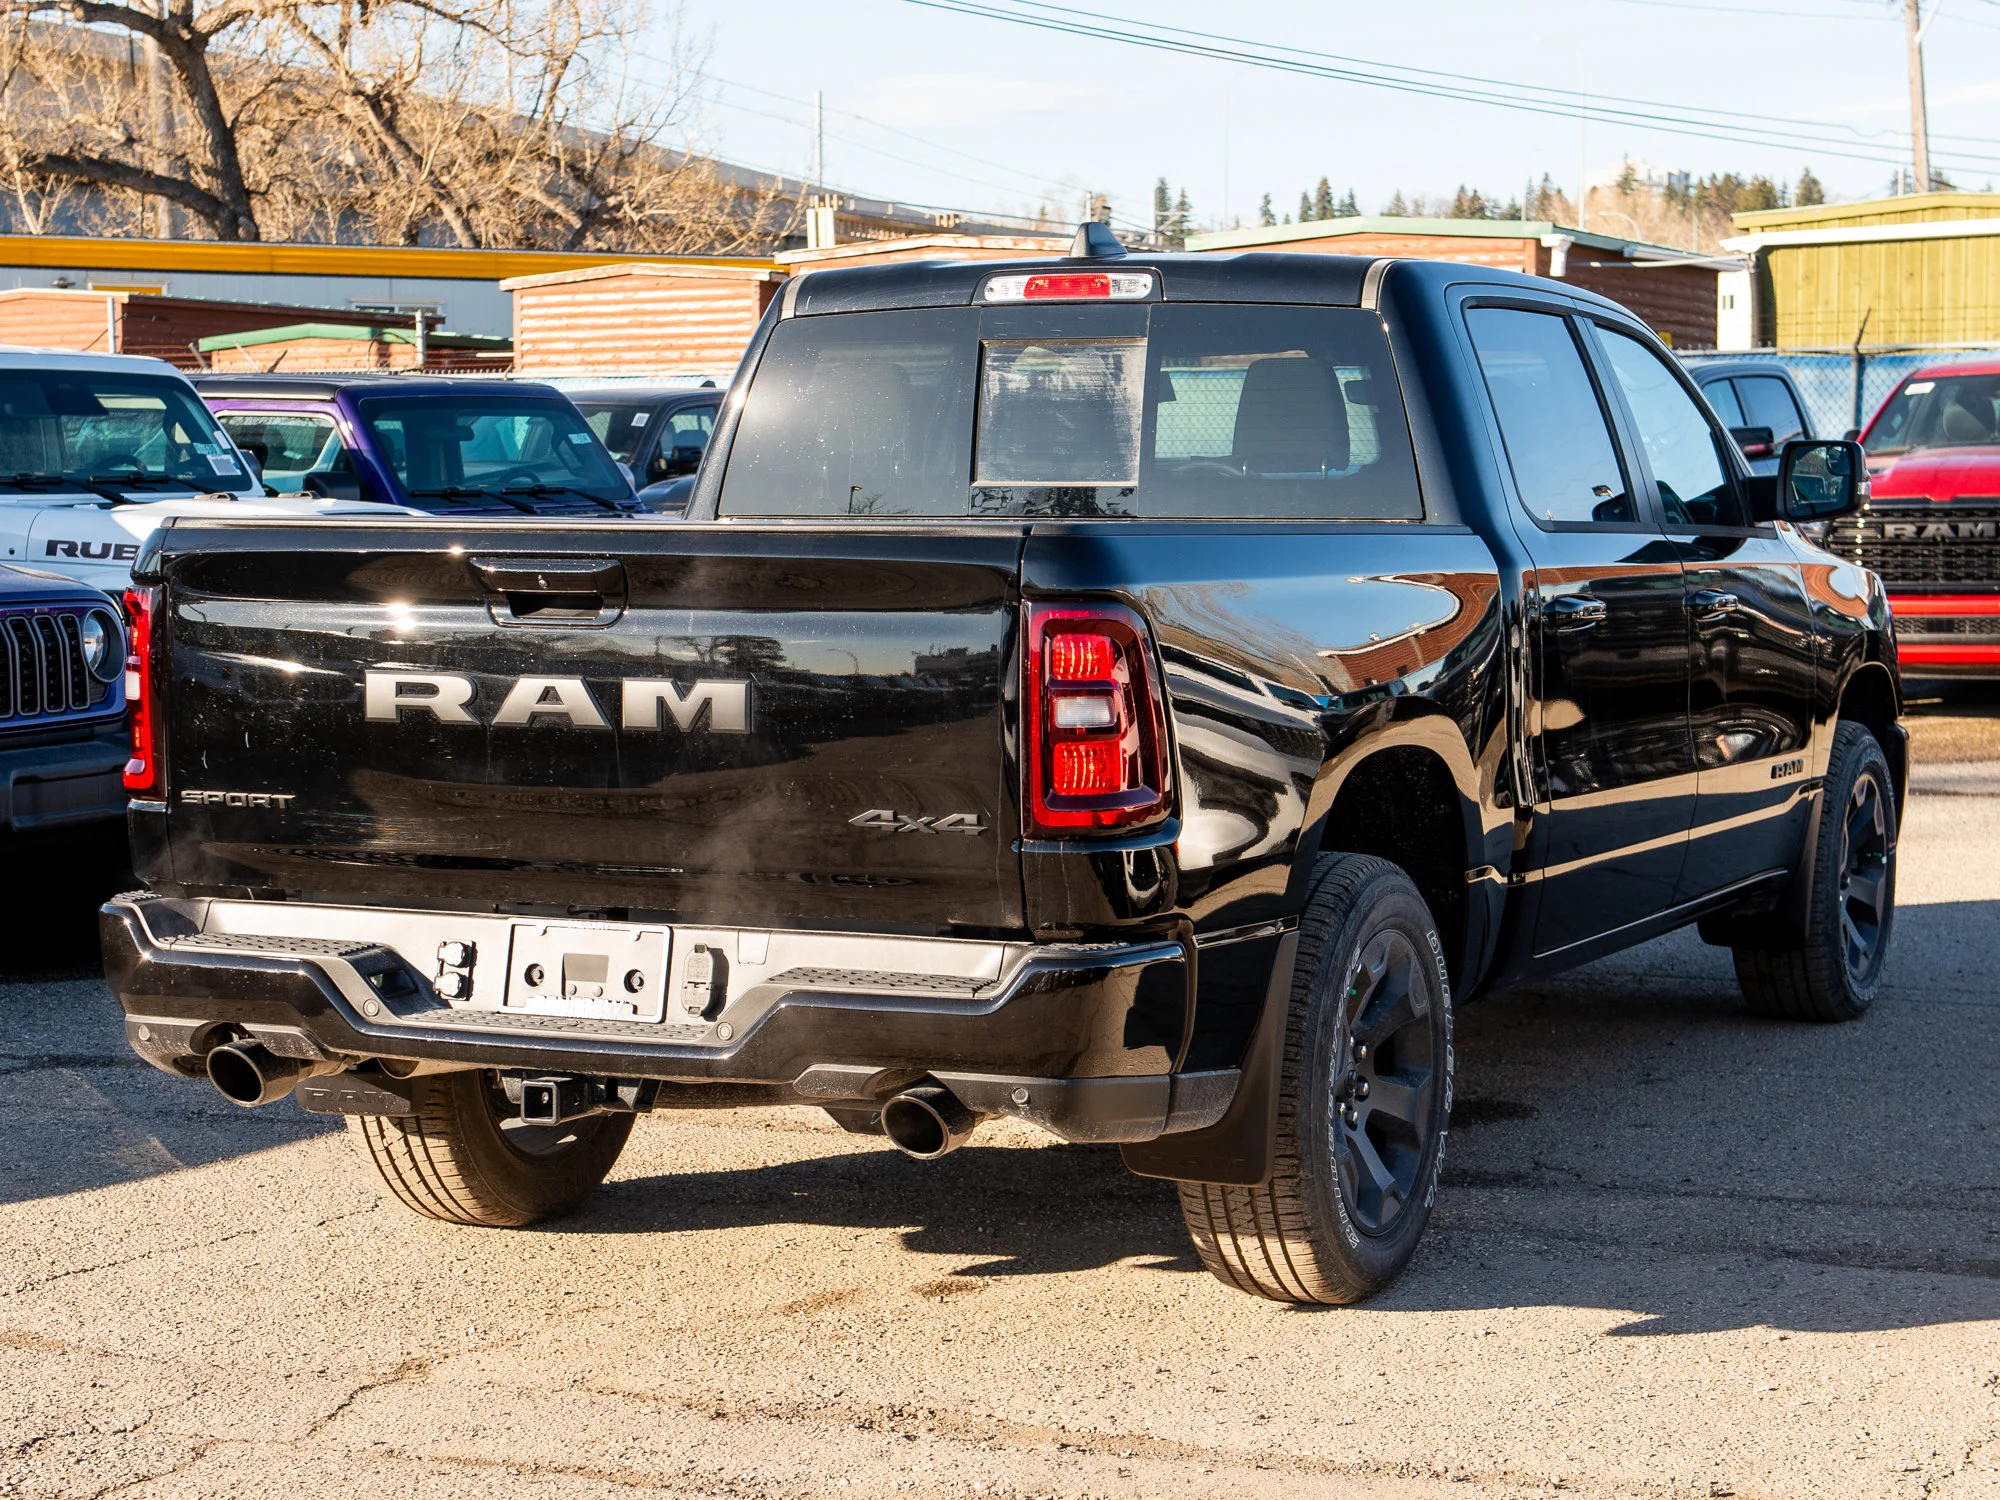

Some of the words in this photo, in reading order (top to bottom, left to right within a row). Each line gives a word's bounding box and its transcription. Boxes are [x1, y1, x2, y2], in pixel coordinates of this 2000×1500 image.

[1884, 523, 1996, 538] RAM
[365, 669, 752, 735] RAM
[1771, 758, 1804, 779] RAM
[181, 790, 296, 809] SPORT
[1426, 929, 1455, 1114] DUELER
[1326, 939, 1362, 1249] BRIDGESTONE
